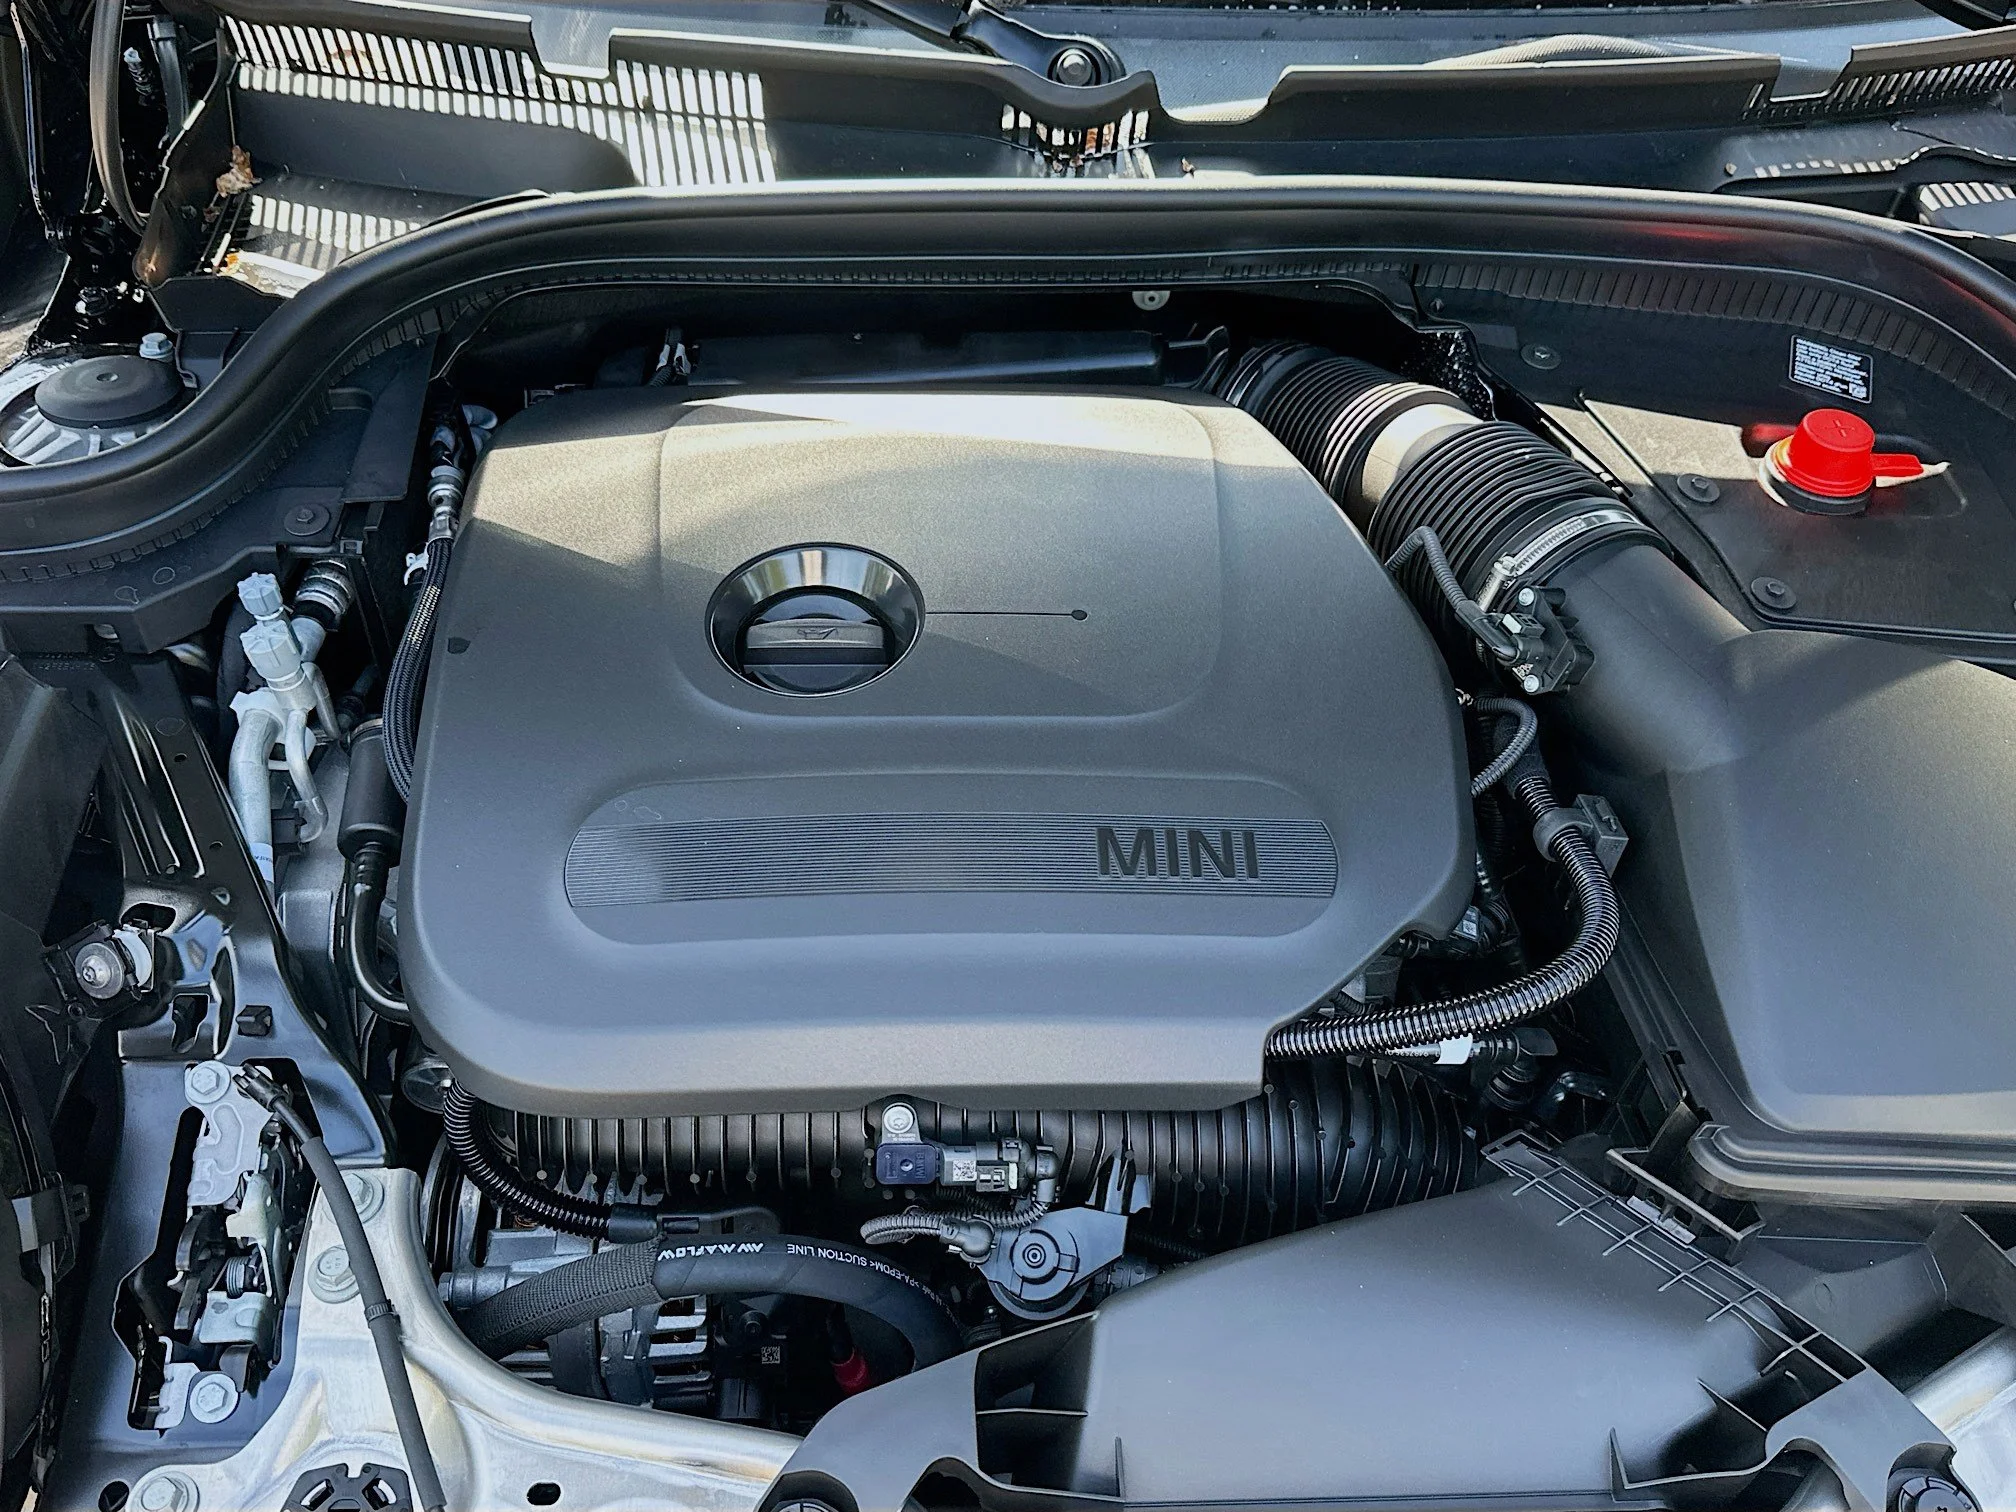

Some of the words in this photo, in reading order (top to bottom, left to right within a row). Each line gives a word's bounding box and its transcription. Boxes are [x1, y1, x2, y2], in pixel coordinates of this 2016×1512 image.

[1096, 827, 1260, 880] MINI
[657, 1243, 736, 1261] MAFLOW
[786, 1243, 815, 1256] LINE
[817, 1246, 867, 1267] SUCTION
